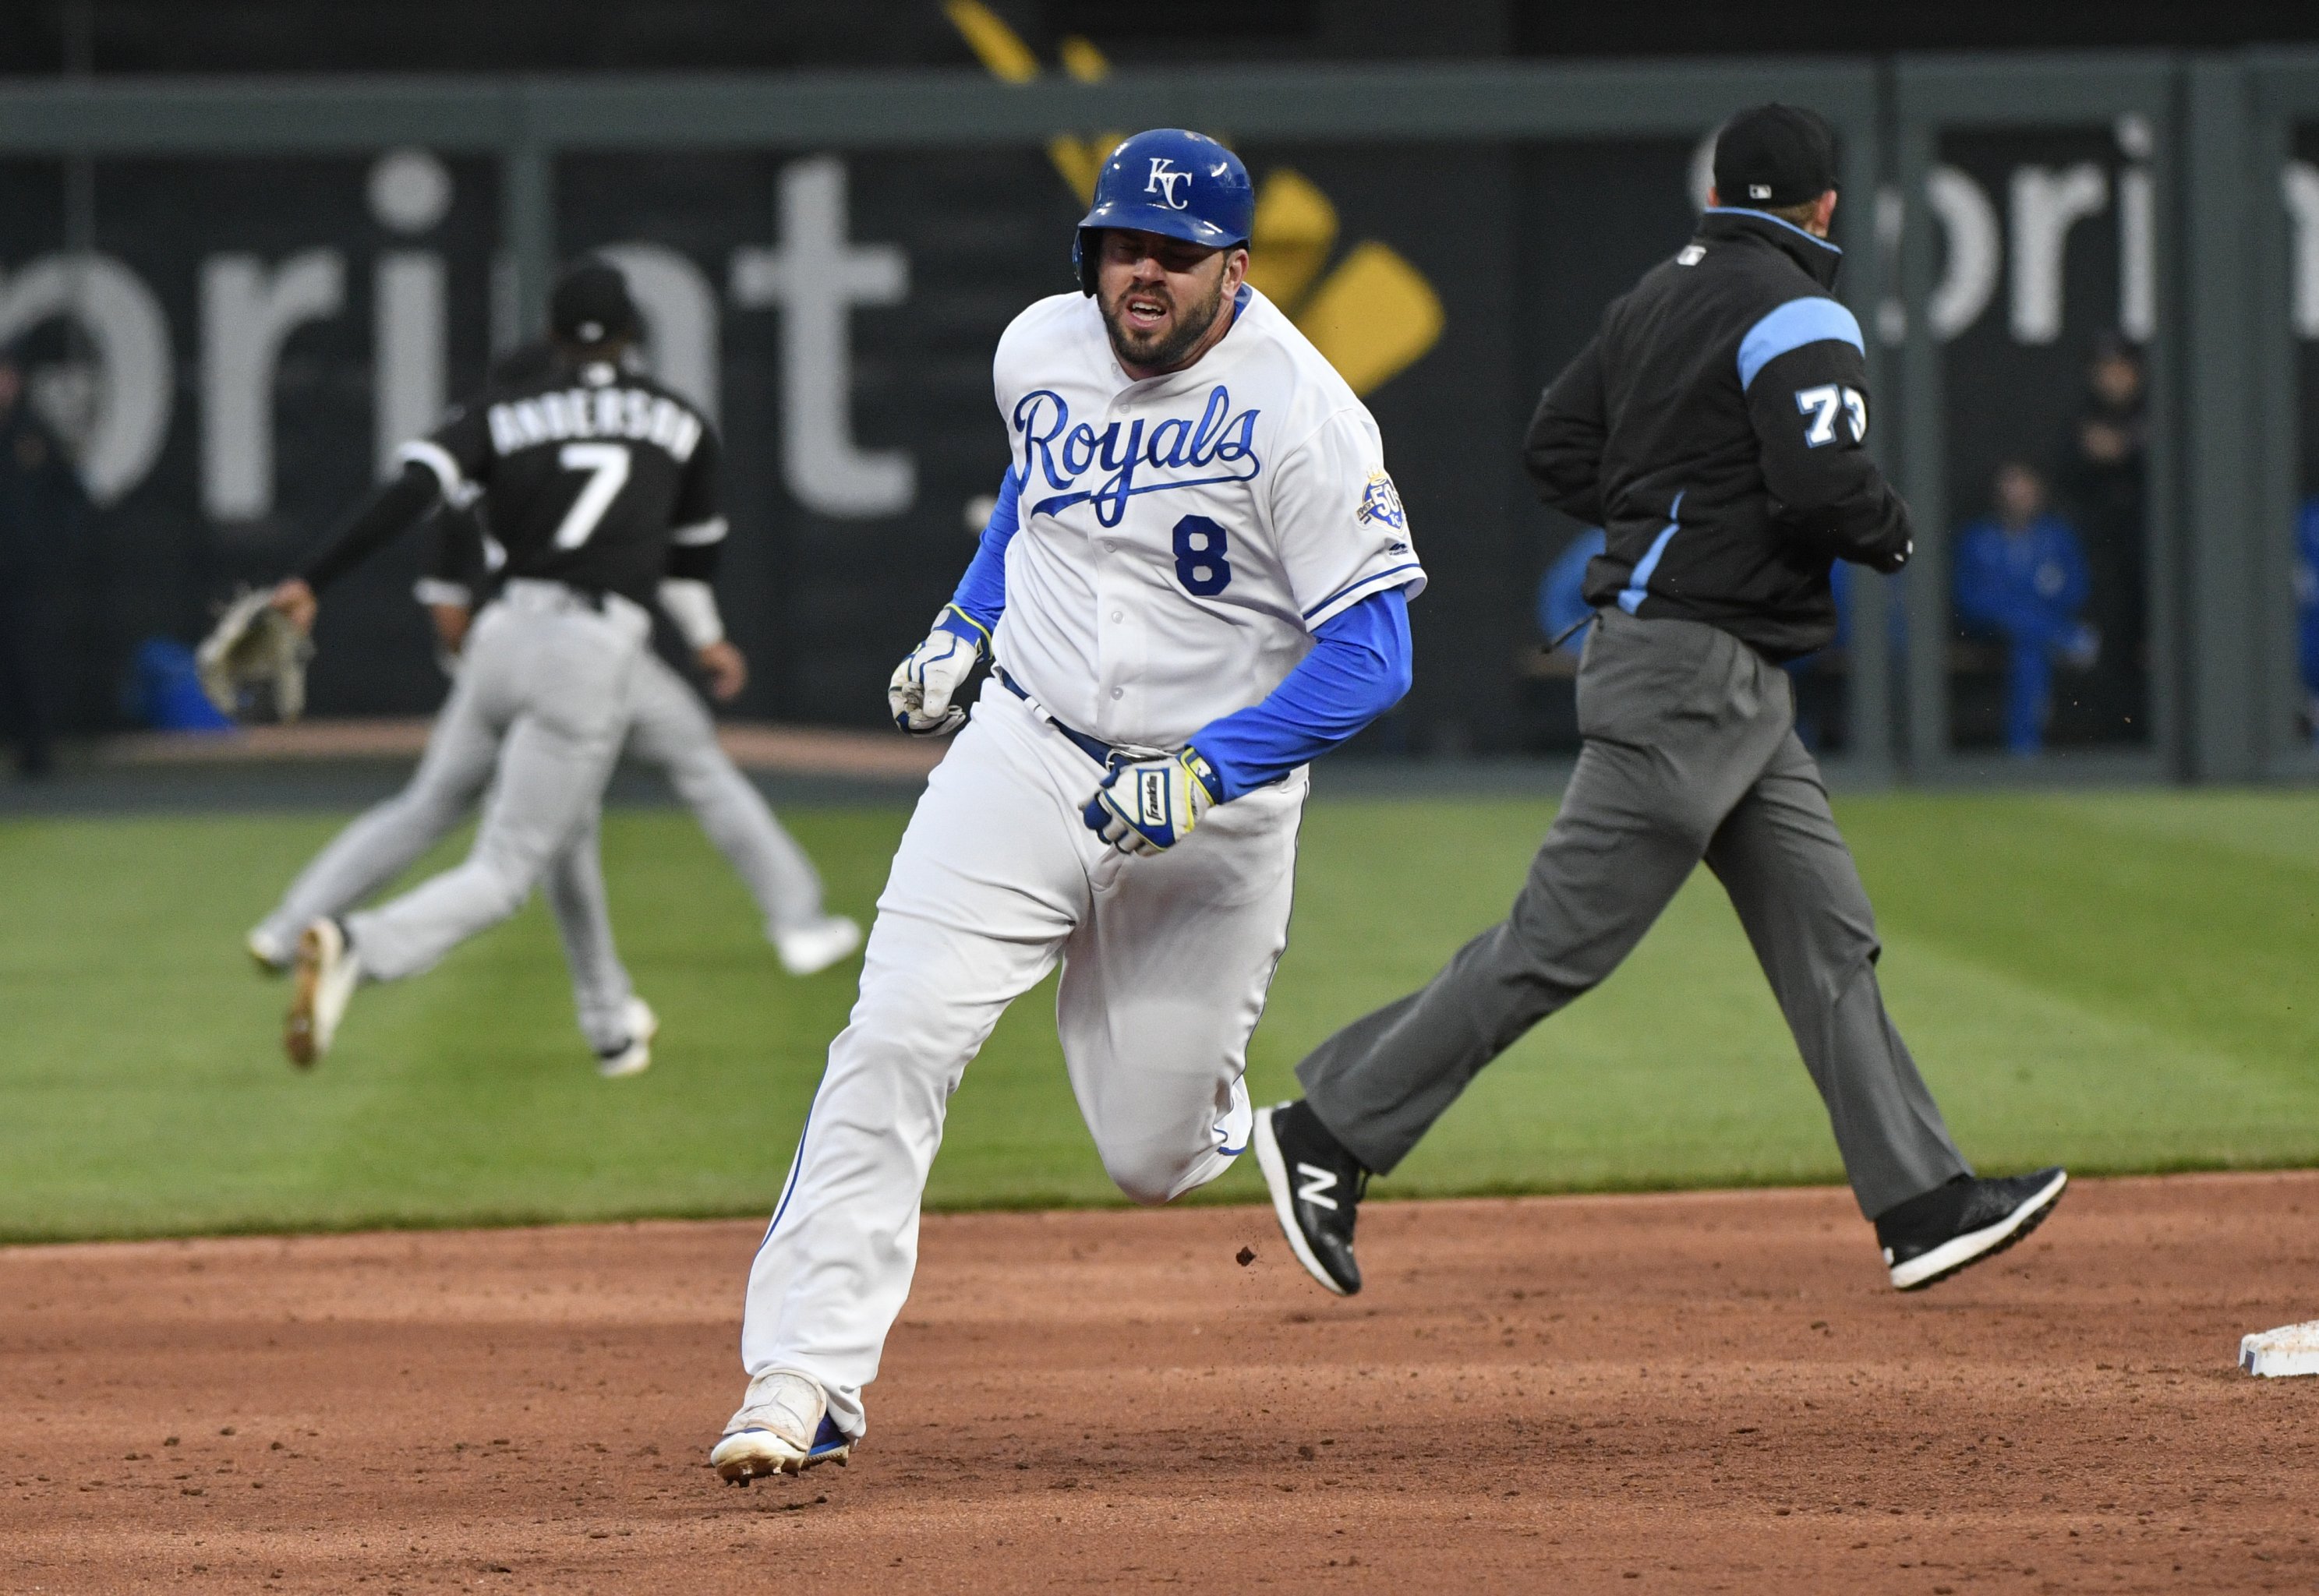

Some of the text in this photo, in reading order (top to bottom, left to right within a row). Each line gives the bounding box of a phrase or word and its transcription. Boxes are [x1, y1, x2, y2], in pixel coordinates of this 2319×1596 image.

[1144, 157, 1193, 210] KC
[1013, 385, 1260, 528] Royals
[555, 443, 630, 548] 7
[1370, 483, 1400, 517] 50
[1172, 514, 1232, 596] 8
[1297, 1163, 1338, 1211] N
